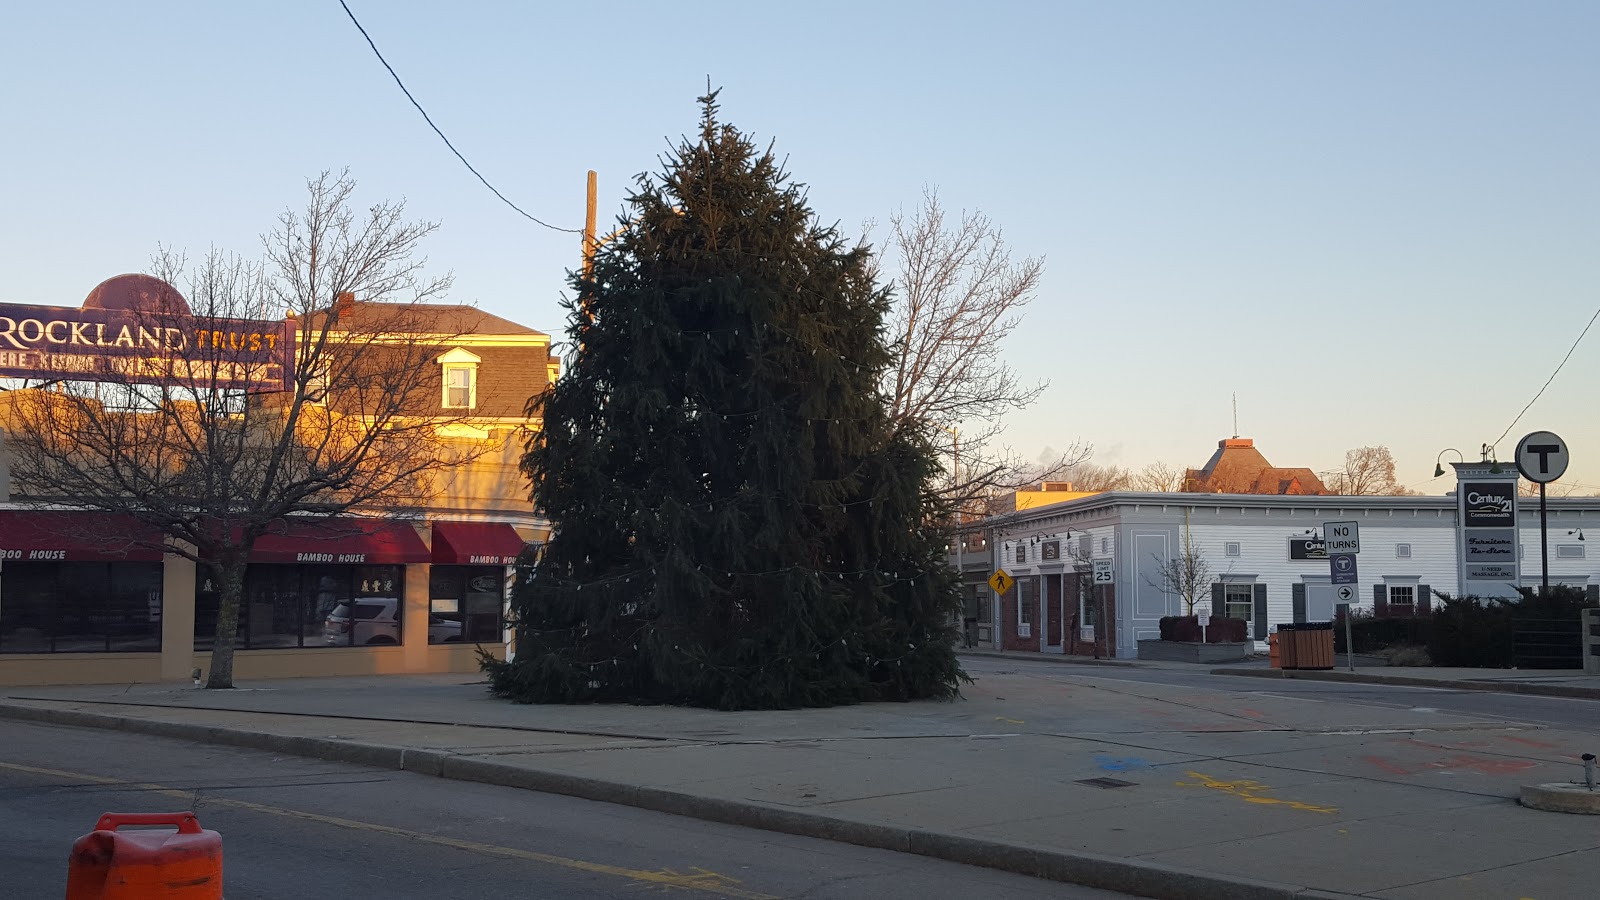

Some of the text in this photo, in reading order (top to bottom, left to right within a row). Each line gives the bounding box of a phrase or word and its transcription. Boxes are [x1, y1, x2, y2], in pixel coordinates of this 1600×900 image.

[0, 316, 280, 351] ROCKLAND TRUST
[1527, 445, 1559, 473] T
[1468, 492, 1512, 512] Century 21
[1333, 527, 1349, 537] NO
[1305, 541, 1325, 550] Centu
[1328, 540, 1357, 549] TURNS
[29, 550, 66, 560] HOUSE
[297, 552, 365, 563] BAMBOO HOUSE
[470, 555, 499, 564] BAMBOO
[1096, 571, 1111, 581] 25
